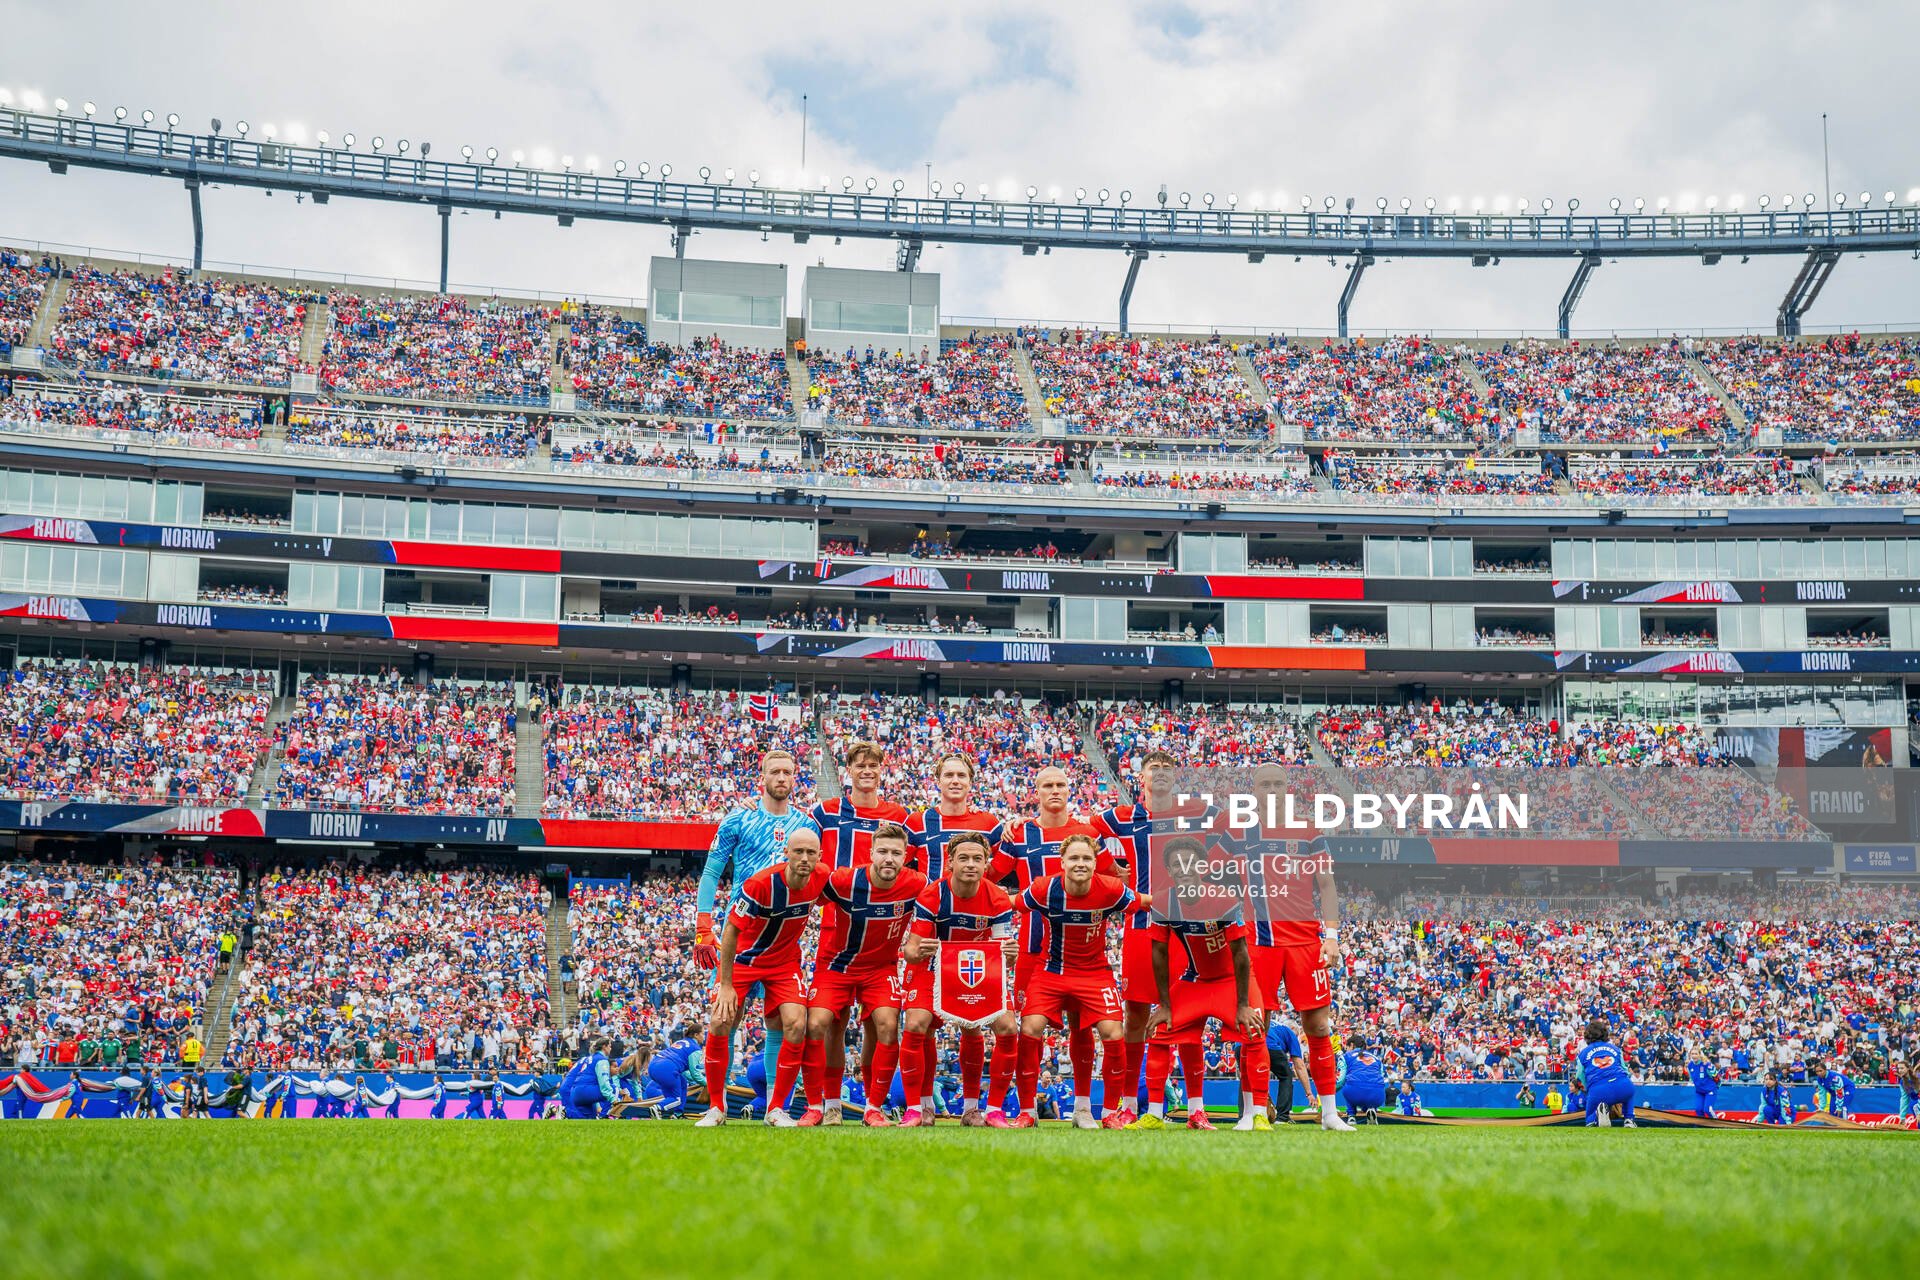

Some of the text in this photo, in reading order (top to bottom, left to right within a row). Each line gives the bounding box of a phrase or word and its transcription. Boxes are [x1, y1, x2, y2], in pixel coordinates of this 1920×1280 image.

[33, 518, 83, 541] RANCE
[161, 527, 215, 550] NORWA
[893, 567, 935, 587] RANCE
[1003, 571, 1050, 590] NORWA
[1686, 582, 1728, 600] RANCE
[1796, 581, 1846, 600] NORWA
[28, 596, 78, 618] RANCE
[157, 605, 212, 627] NORWA
[892, 639, 935, 660] RANCE
[1003, 643, 1051, 662] NORWA
[1689, 652, 1732, 671] RANCE
[1801, 652, 1851, 671] NORWA
[1810, 791, 1864, 814] FRANC
[20, 803, 43, 827] FR
[177, 808, 223, 832] ANCE
[310, 813, 362, 837] NORW
[485, 819, 507, 841] AY
[1380, 839, 1400, 861] AY
[1868, 851, 1891, 860] FIFA
[887, 920, 902, 940] 15
[1204, 932, 1227, 954] 22
